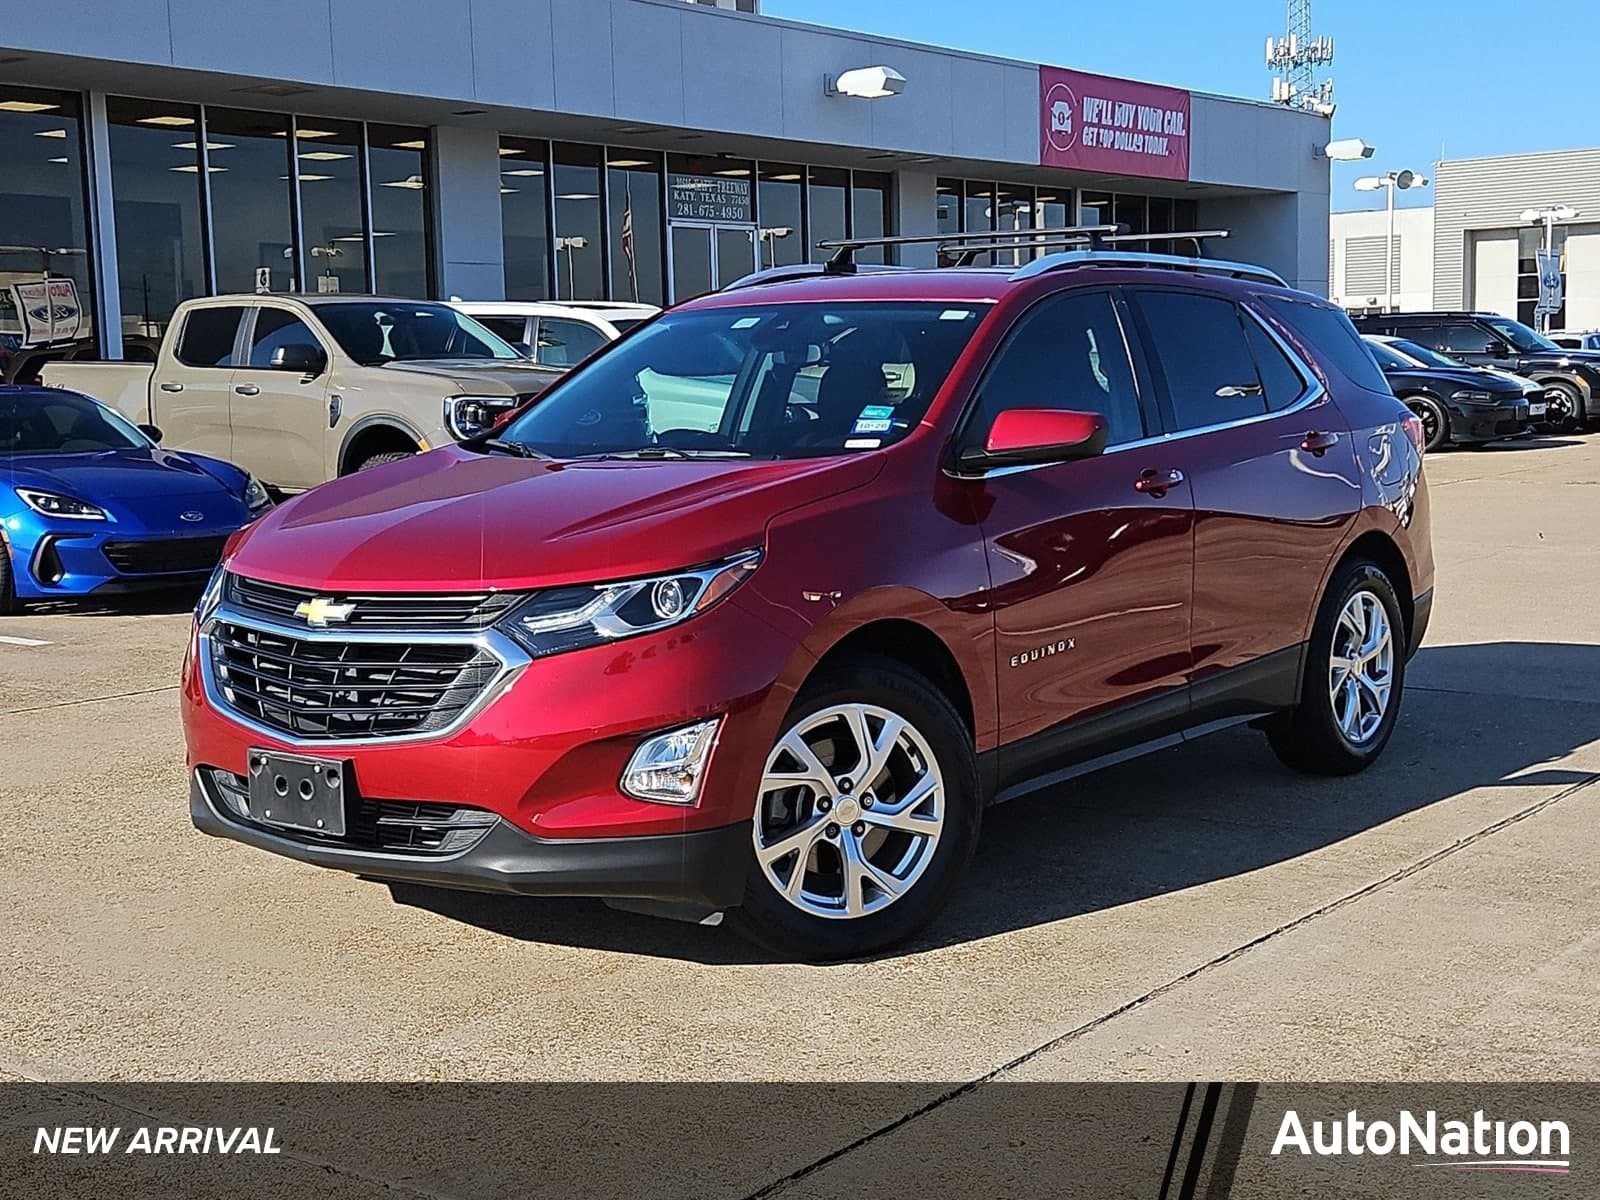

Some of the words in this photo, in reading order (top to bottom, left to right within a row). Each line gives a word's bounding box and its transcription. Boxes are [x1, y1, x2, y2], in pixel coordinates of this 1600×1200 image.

[1083, 96, 1112, 125] WE'LL
[1114, 101, 1136, 128] BUY
[1137, 105, 1163, 133] YOUR
[1164, 109, 1185, 136] CAR.
[1082, 126, 1098, 147] GET
[1099, 128, 1114, 149] TOP
[1114, 130, 1143, 153] DOLLAR
[700, 192, 726, 204] TEXAS
[717, 180, 748, 195] FREEWAY
[1010, 637, 1076, 667] EQUINOX
